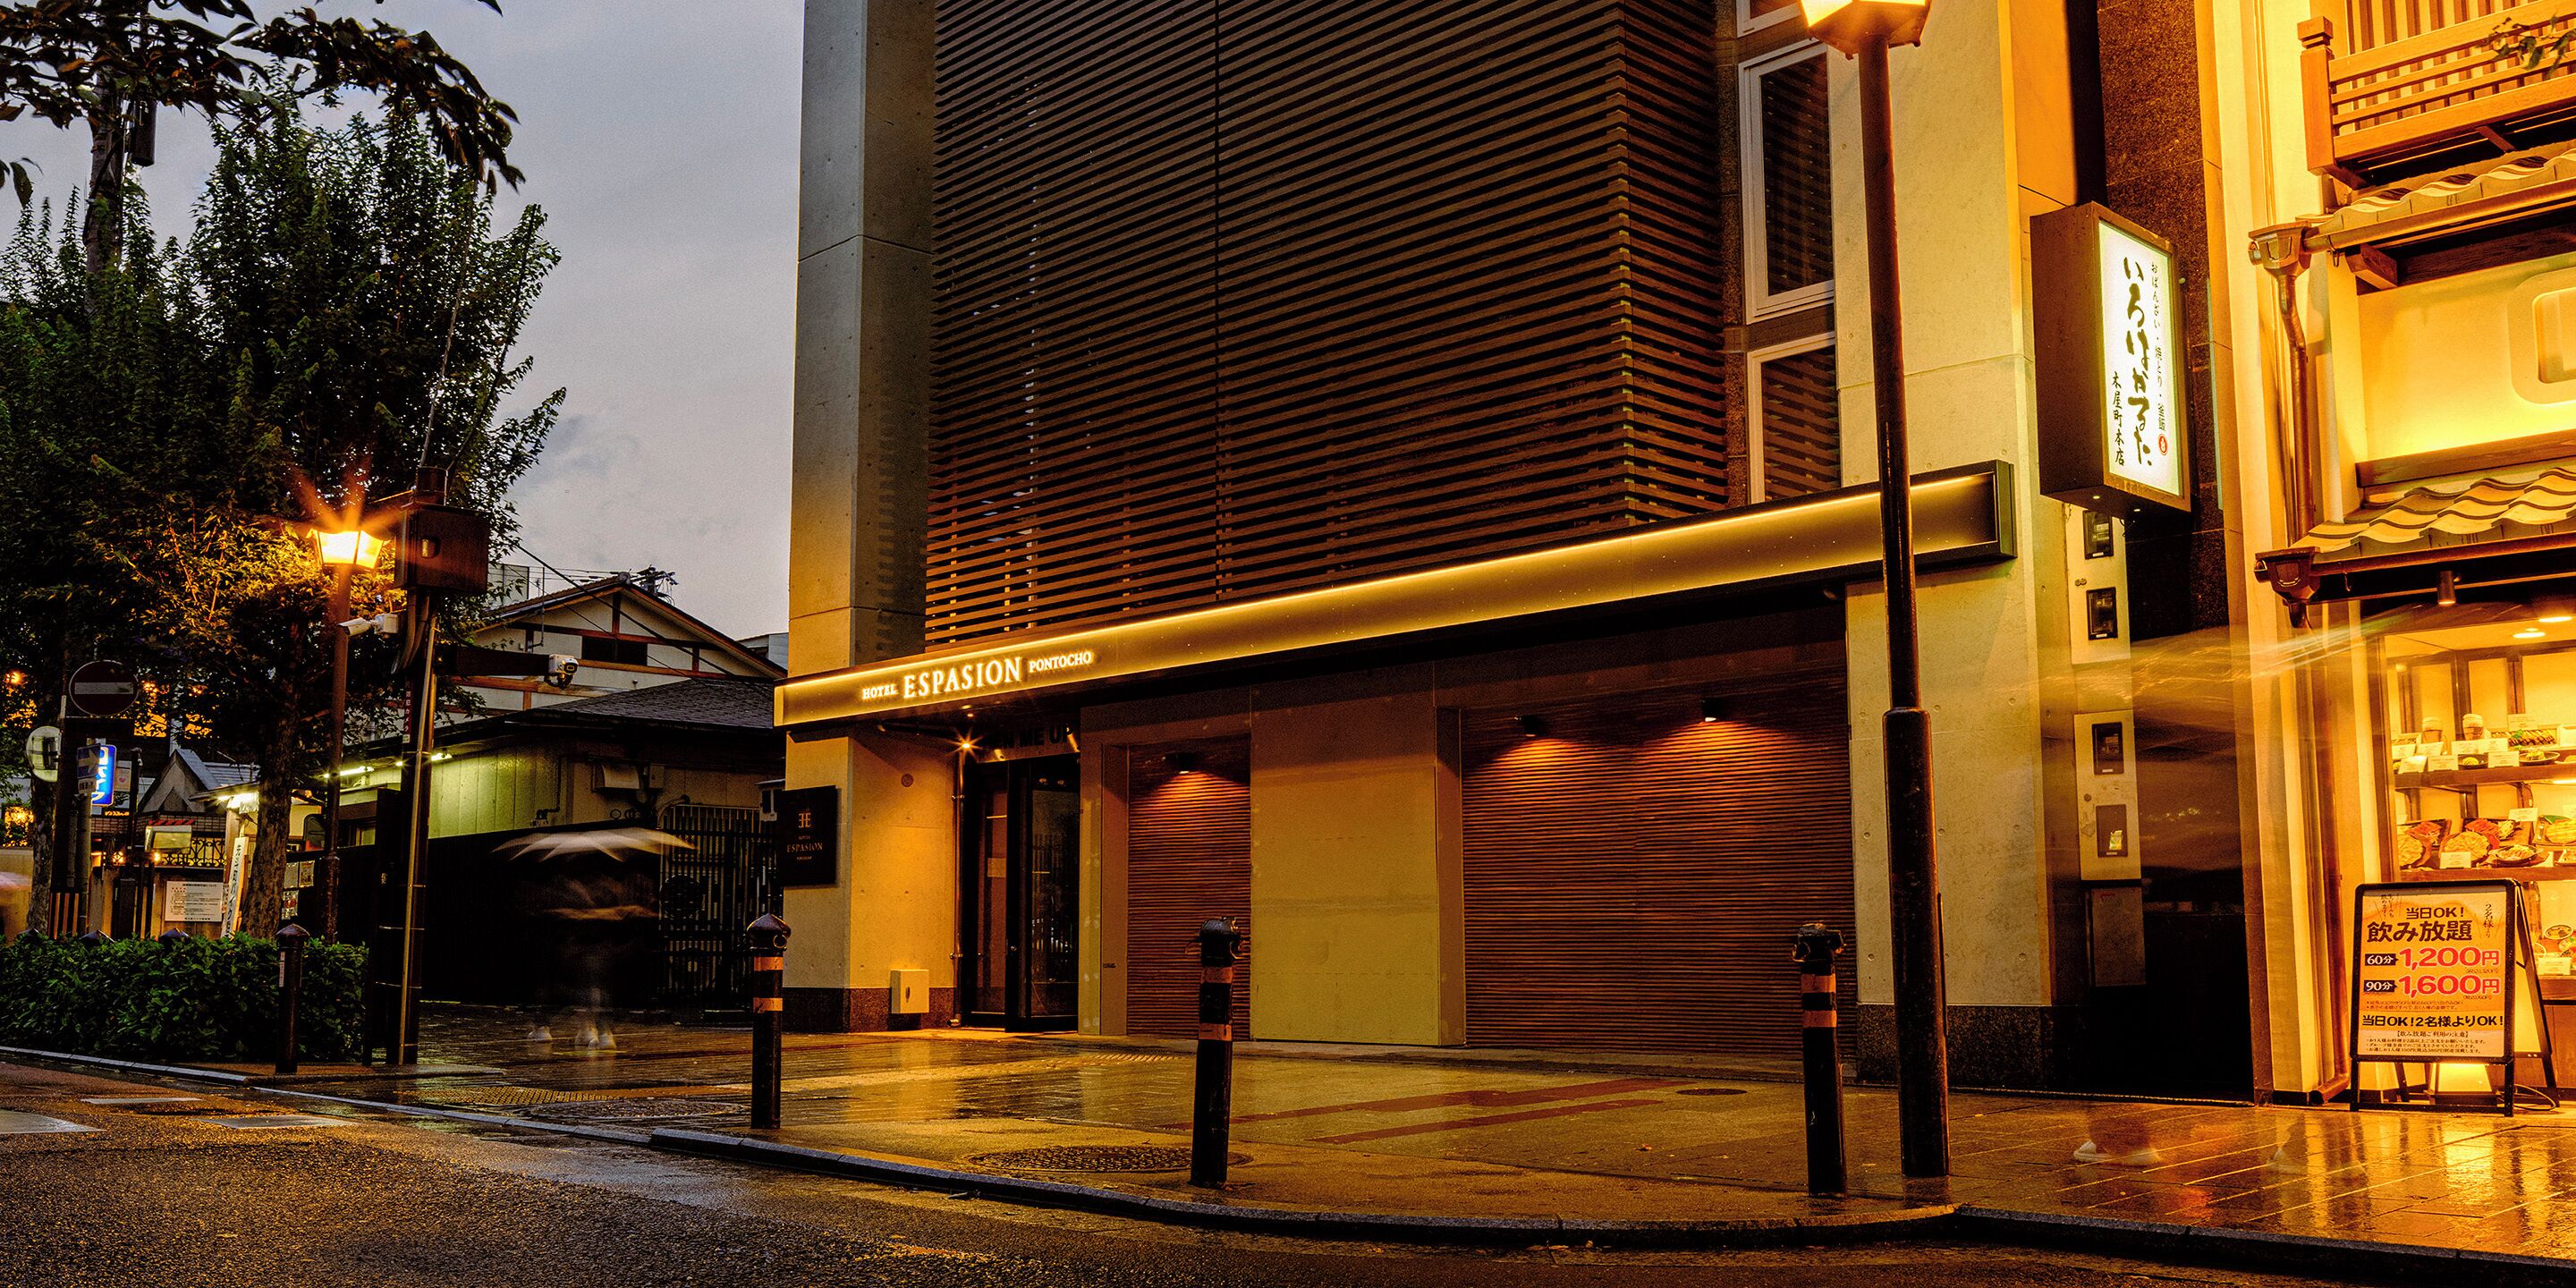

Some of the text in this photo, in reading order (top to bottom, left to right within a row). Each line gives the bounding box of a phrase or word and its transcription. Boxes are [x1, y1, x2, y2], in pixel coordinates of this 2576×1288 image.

[2123, 256, 2152, 467] いろはかるた
[2111, 371, 2124, 467] 木屋町本店
[862, 651, 1093, 700] HOTEL ESPASION PONTOCHO
[786, 843, 823, 852] ESPASION
[2406, 906, 2464, 919] 当日OK!
[2367, 919, 2472, 942] 飲み放題
[2366, 946, 2501, 970] 60分 1,200円
[2366, 975, 2501, 998] 90分 1,600円
